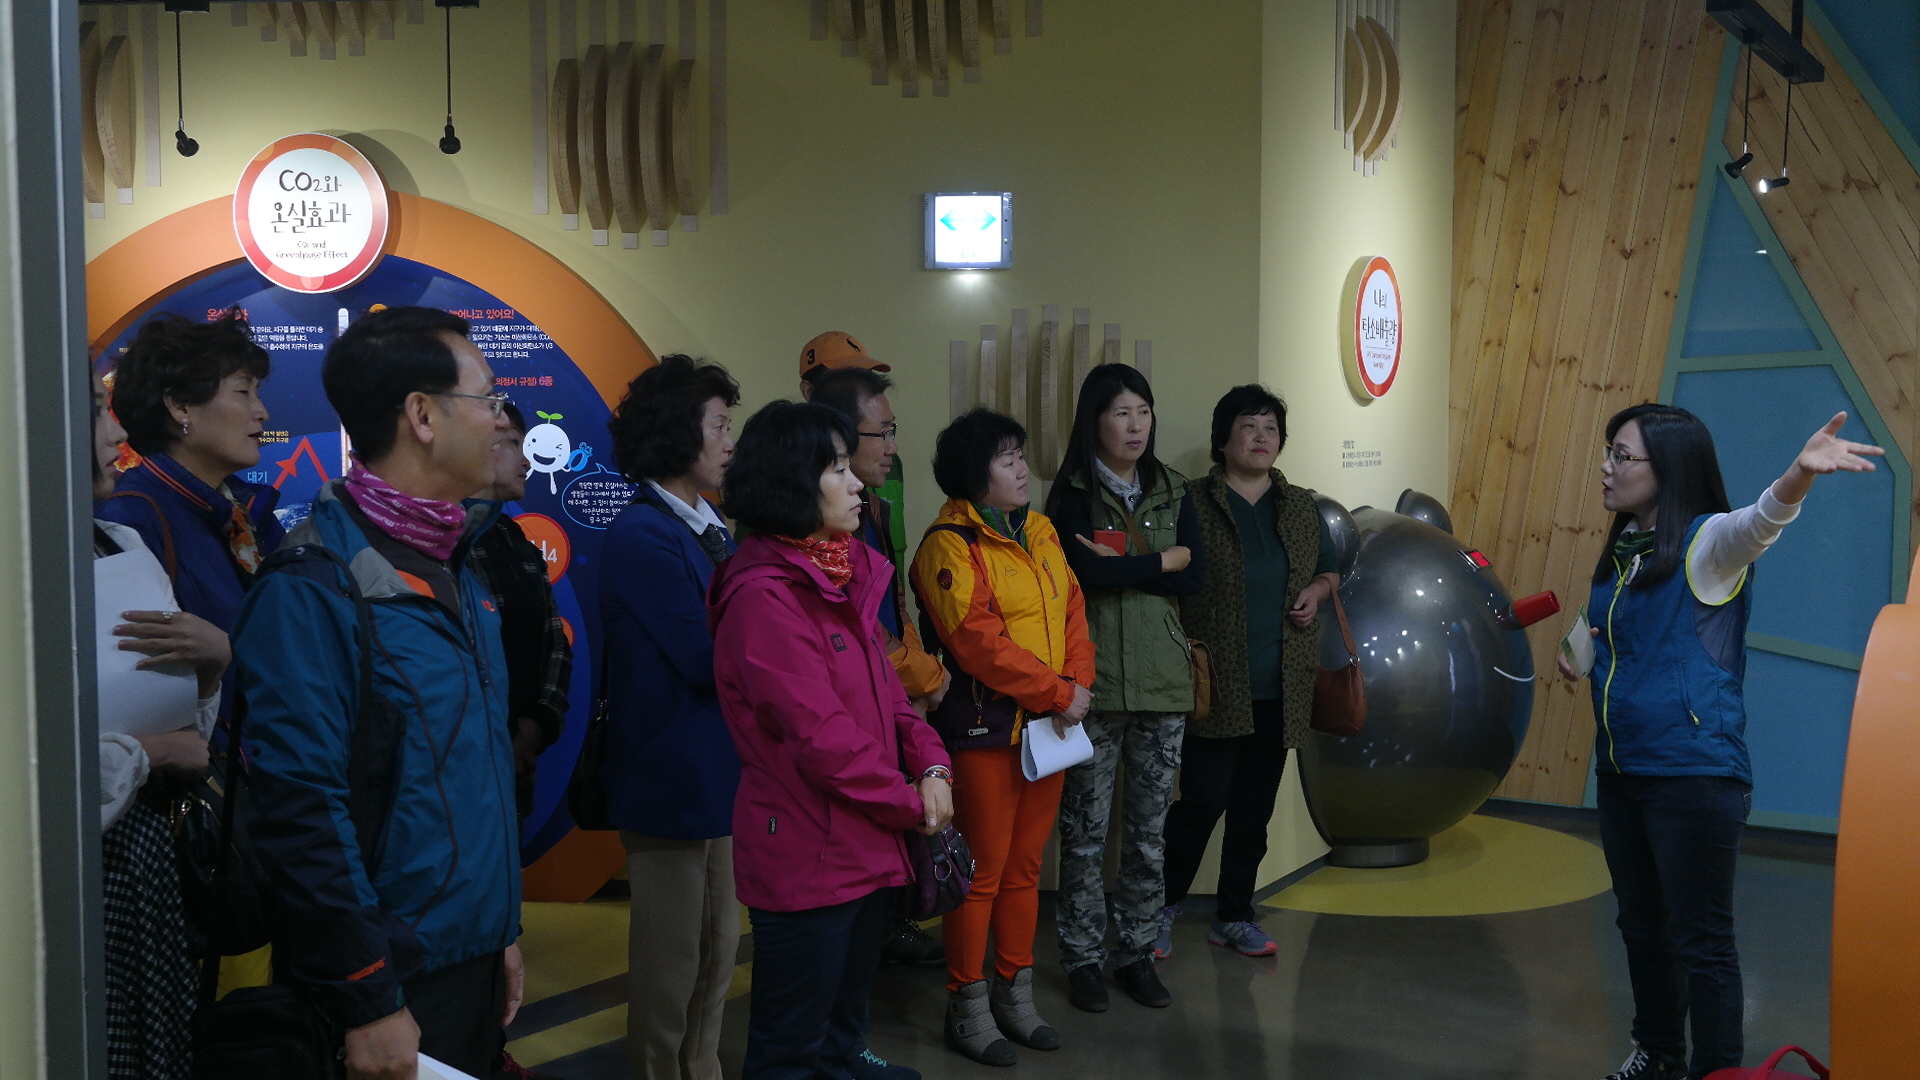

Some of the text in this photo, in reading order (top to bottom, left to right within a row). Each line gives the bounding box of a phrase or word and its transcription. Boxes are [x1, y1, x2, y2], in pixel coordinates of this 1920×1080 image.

[270, 199, 352, 234] 온실효과
[311, 239, 327, 249] and
[275, 250, 348, 259] Greenhouse Effect
[485, 308, 515, 320] 있어요!
[1361, 315, 1398, 347] 탄소배출량
[806, 348, 816, 366] 3
[519, 377, 537, 387] 규정)
[538, 375, 554, 387] 6종
[247, 470, 268, 484] 대기
